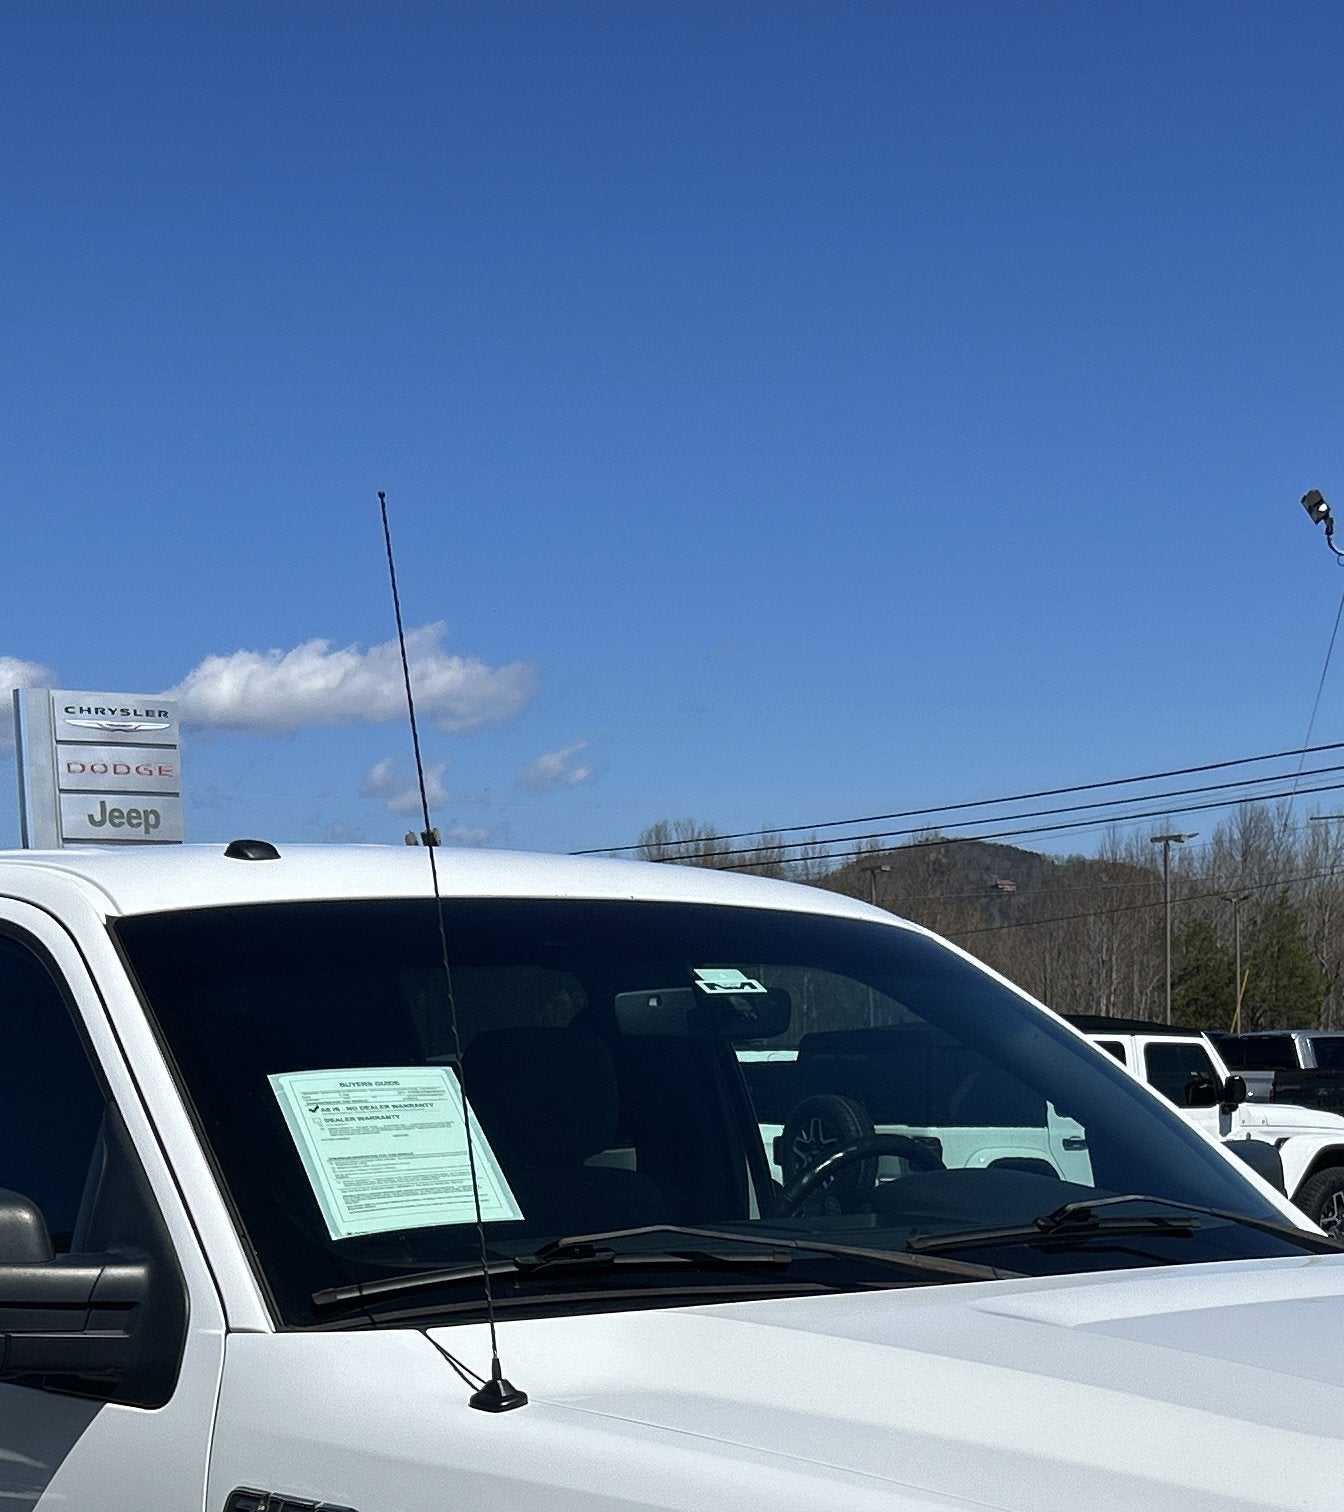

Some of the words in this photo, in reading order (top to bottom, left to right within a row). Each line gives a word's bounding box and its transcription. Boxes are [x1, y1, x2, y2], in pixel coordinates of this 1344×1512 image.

[64, 706, 169, 718] CHRYSLER
[66, 761, 174, 777] DODGE
[88, 800, 161, 834] Jeep
